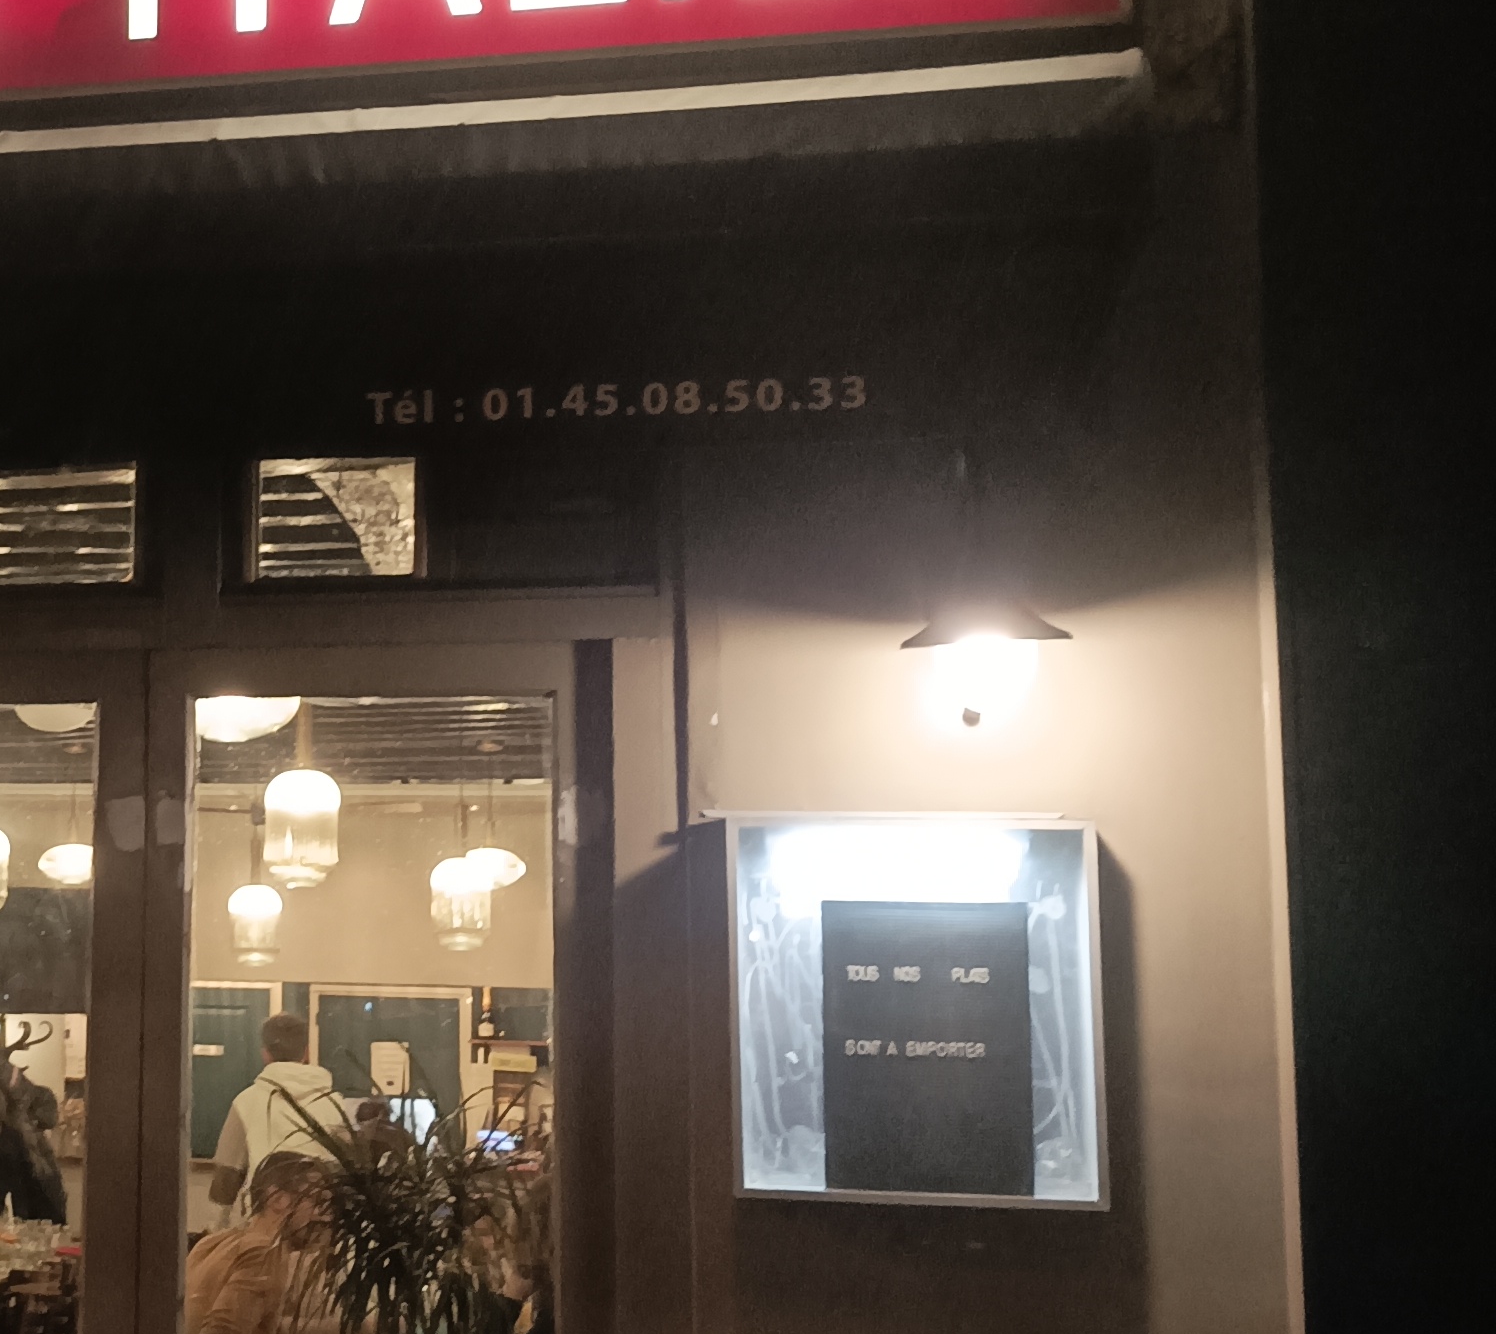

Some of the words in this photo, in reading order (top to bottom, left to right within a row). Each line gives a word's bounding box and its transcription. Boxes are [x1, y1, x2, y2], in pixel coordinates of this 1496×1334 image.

[365, 389, 436, 426] Tél
[481, 374, 868, 423] 01.45.08.50.33
[886, 1040, 898, 1056] A
